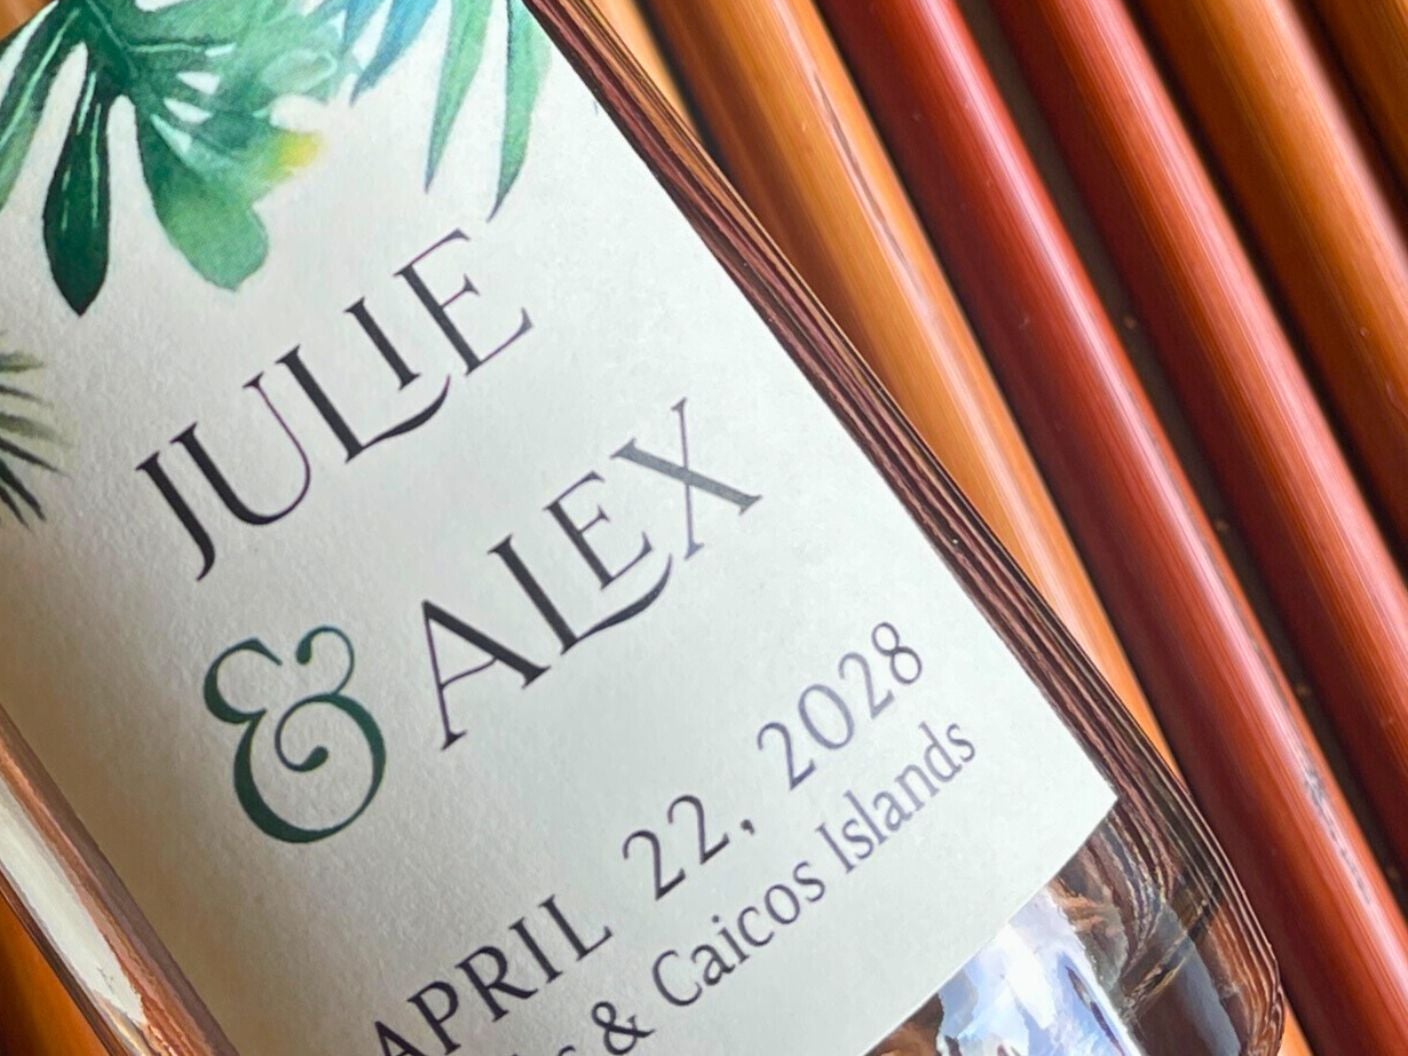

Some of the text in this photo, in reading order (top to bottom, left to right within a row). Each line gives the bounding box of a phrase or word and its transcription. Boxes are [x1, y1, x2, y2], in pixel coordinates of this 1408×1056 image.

[134, 227, 535, 583] JULIE
[201, 396, 764, 845] & ALEX
[620, 793, 758, 903] 22,
[755, 620, 924, 793] 2028
[589, 720, 978, 1056] & Caicos Islands
